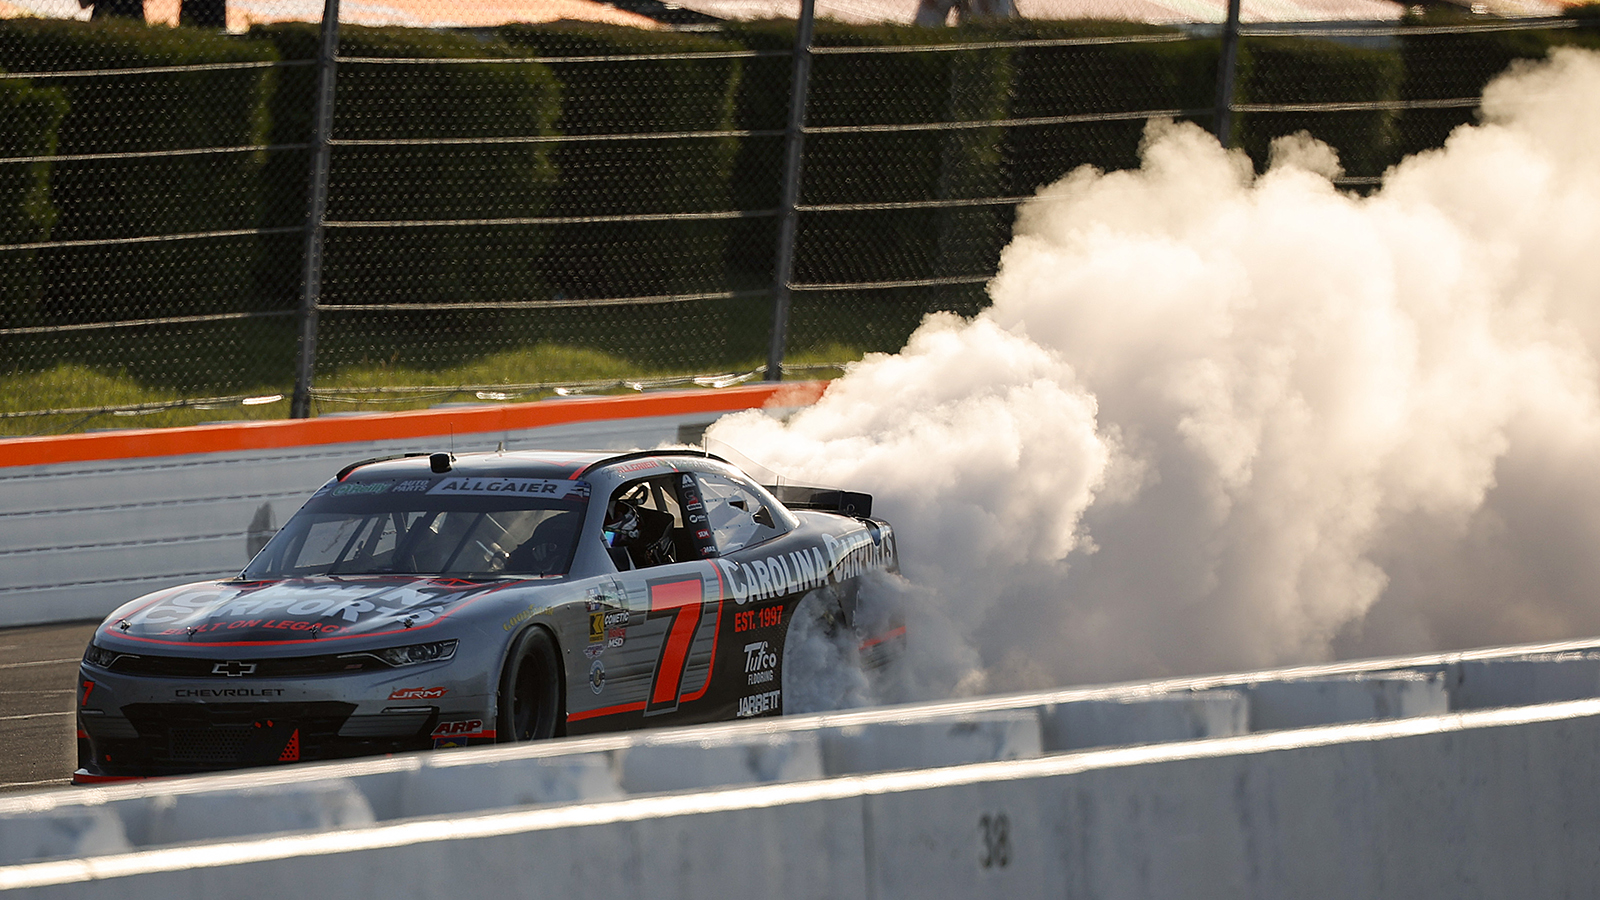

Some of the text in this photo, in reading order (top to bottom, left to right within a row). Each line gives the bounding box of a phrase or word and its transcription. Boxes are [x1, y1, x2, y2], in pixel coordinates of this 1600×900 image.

[441, 480, 558, 494] ALLGAIER
[718, 558, 829, 605] CAROLINA
[226, 619, 261, 630] ON
[734, 605, 783, 632] EST. 1997
[607, 637, 624, 648] MSD
[648, 575, 703, 708] 7
[743, 641, 777, 673] Tufco
[748, 670, 774, 685] FLOORING
[82, 680, 95, 706] 7
[175, 688, 286, 698] CHEVROLET
[392, 689, 442, 699] JRM
[736, 690, 780, 717] JARRETT
[434, 720, 482, 735] ARP
